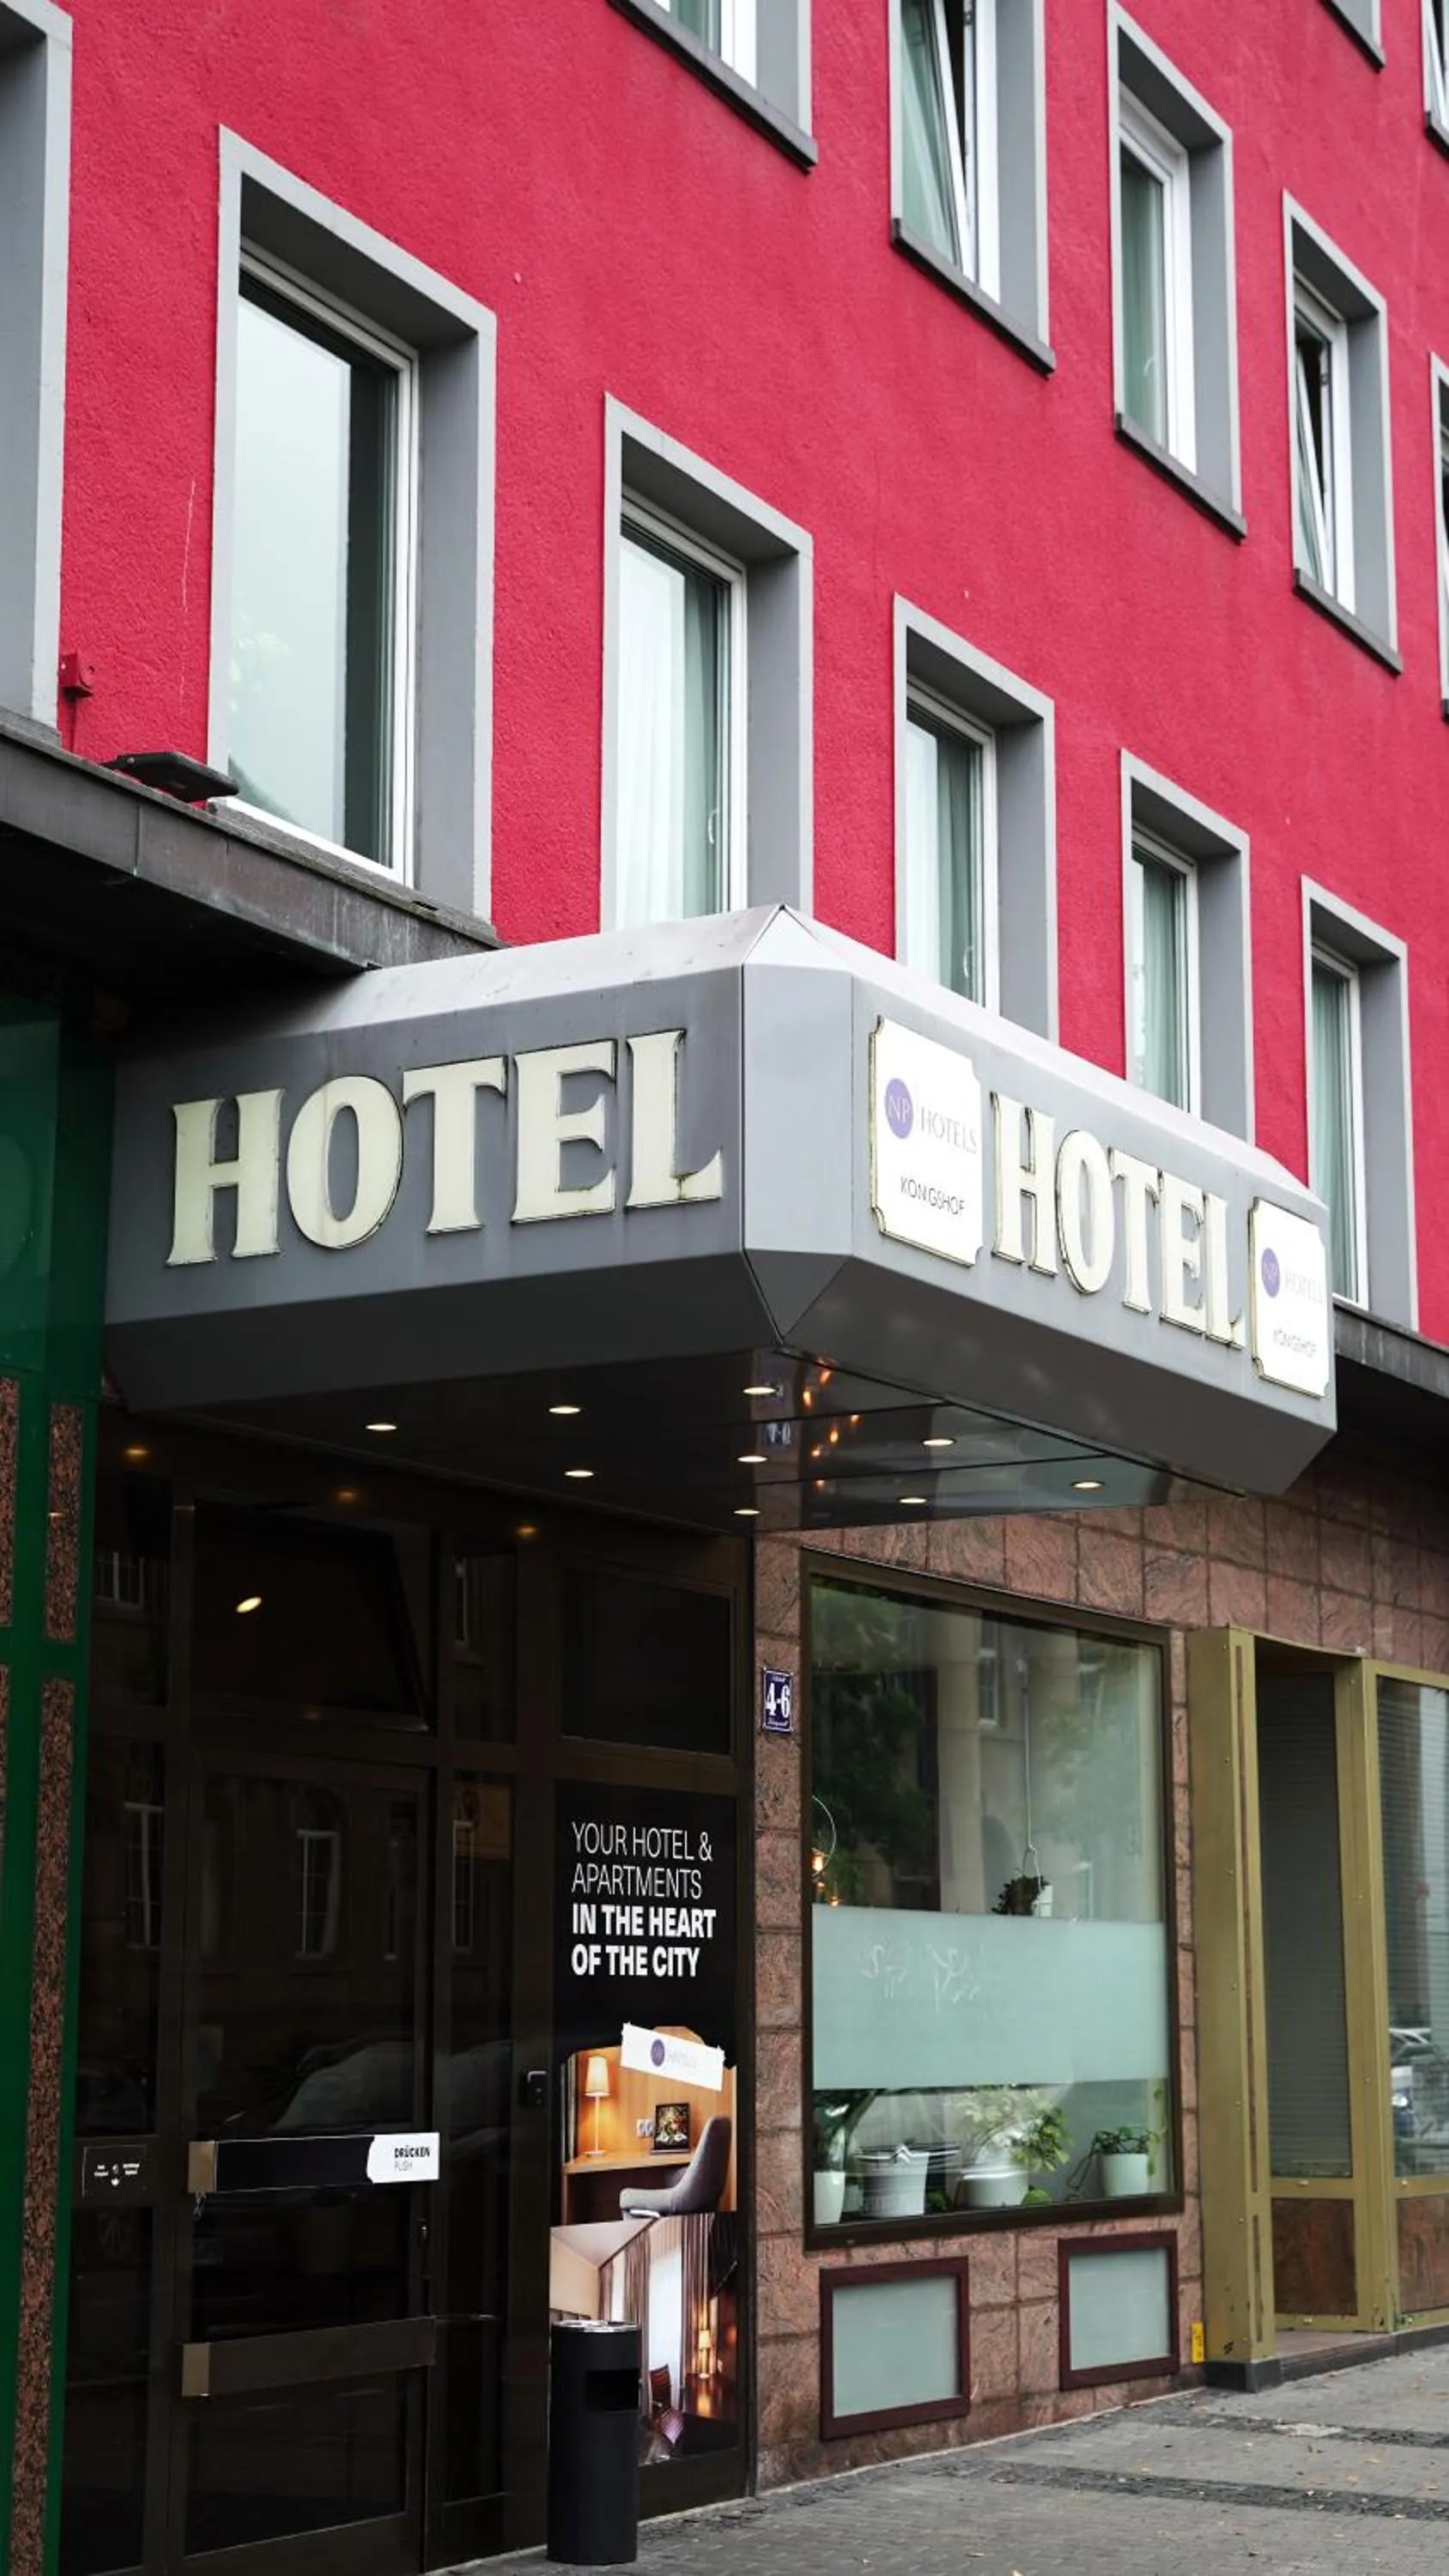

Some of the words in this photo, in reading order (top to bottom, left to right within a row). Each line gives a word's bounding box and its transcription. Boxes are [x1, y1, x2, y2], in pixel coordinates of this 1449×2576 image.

[167, 1029, 723, 1267] HOTEL
[921, 1107, 978, 1155] HOTELS
[991, 1091, 1245, 1349] HOTEL
[766, 1683, 790, 1718] 4-6
[572, 1821, 627, 1856] YOUR
[633, 1826, 694, 1861] HOTEL
[698, 1832, 713, 1862] &
[571, 1862, 702, 1899] APARTMENTS
[573, 1903, 597, 1935] IN
[601, 1904, 644, 1936] THE
[649, 1906, 717, 1939] HEART
[571, 1944, 602, 1976] OF
[605, 1945, 648, 1977] THE
[652, 1946, 700, 1978] CITY
